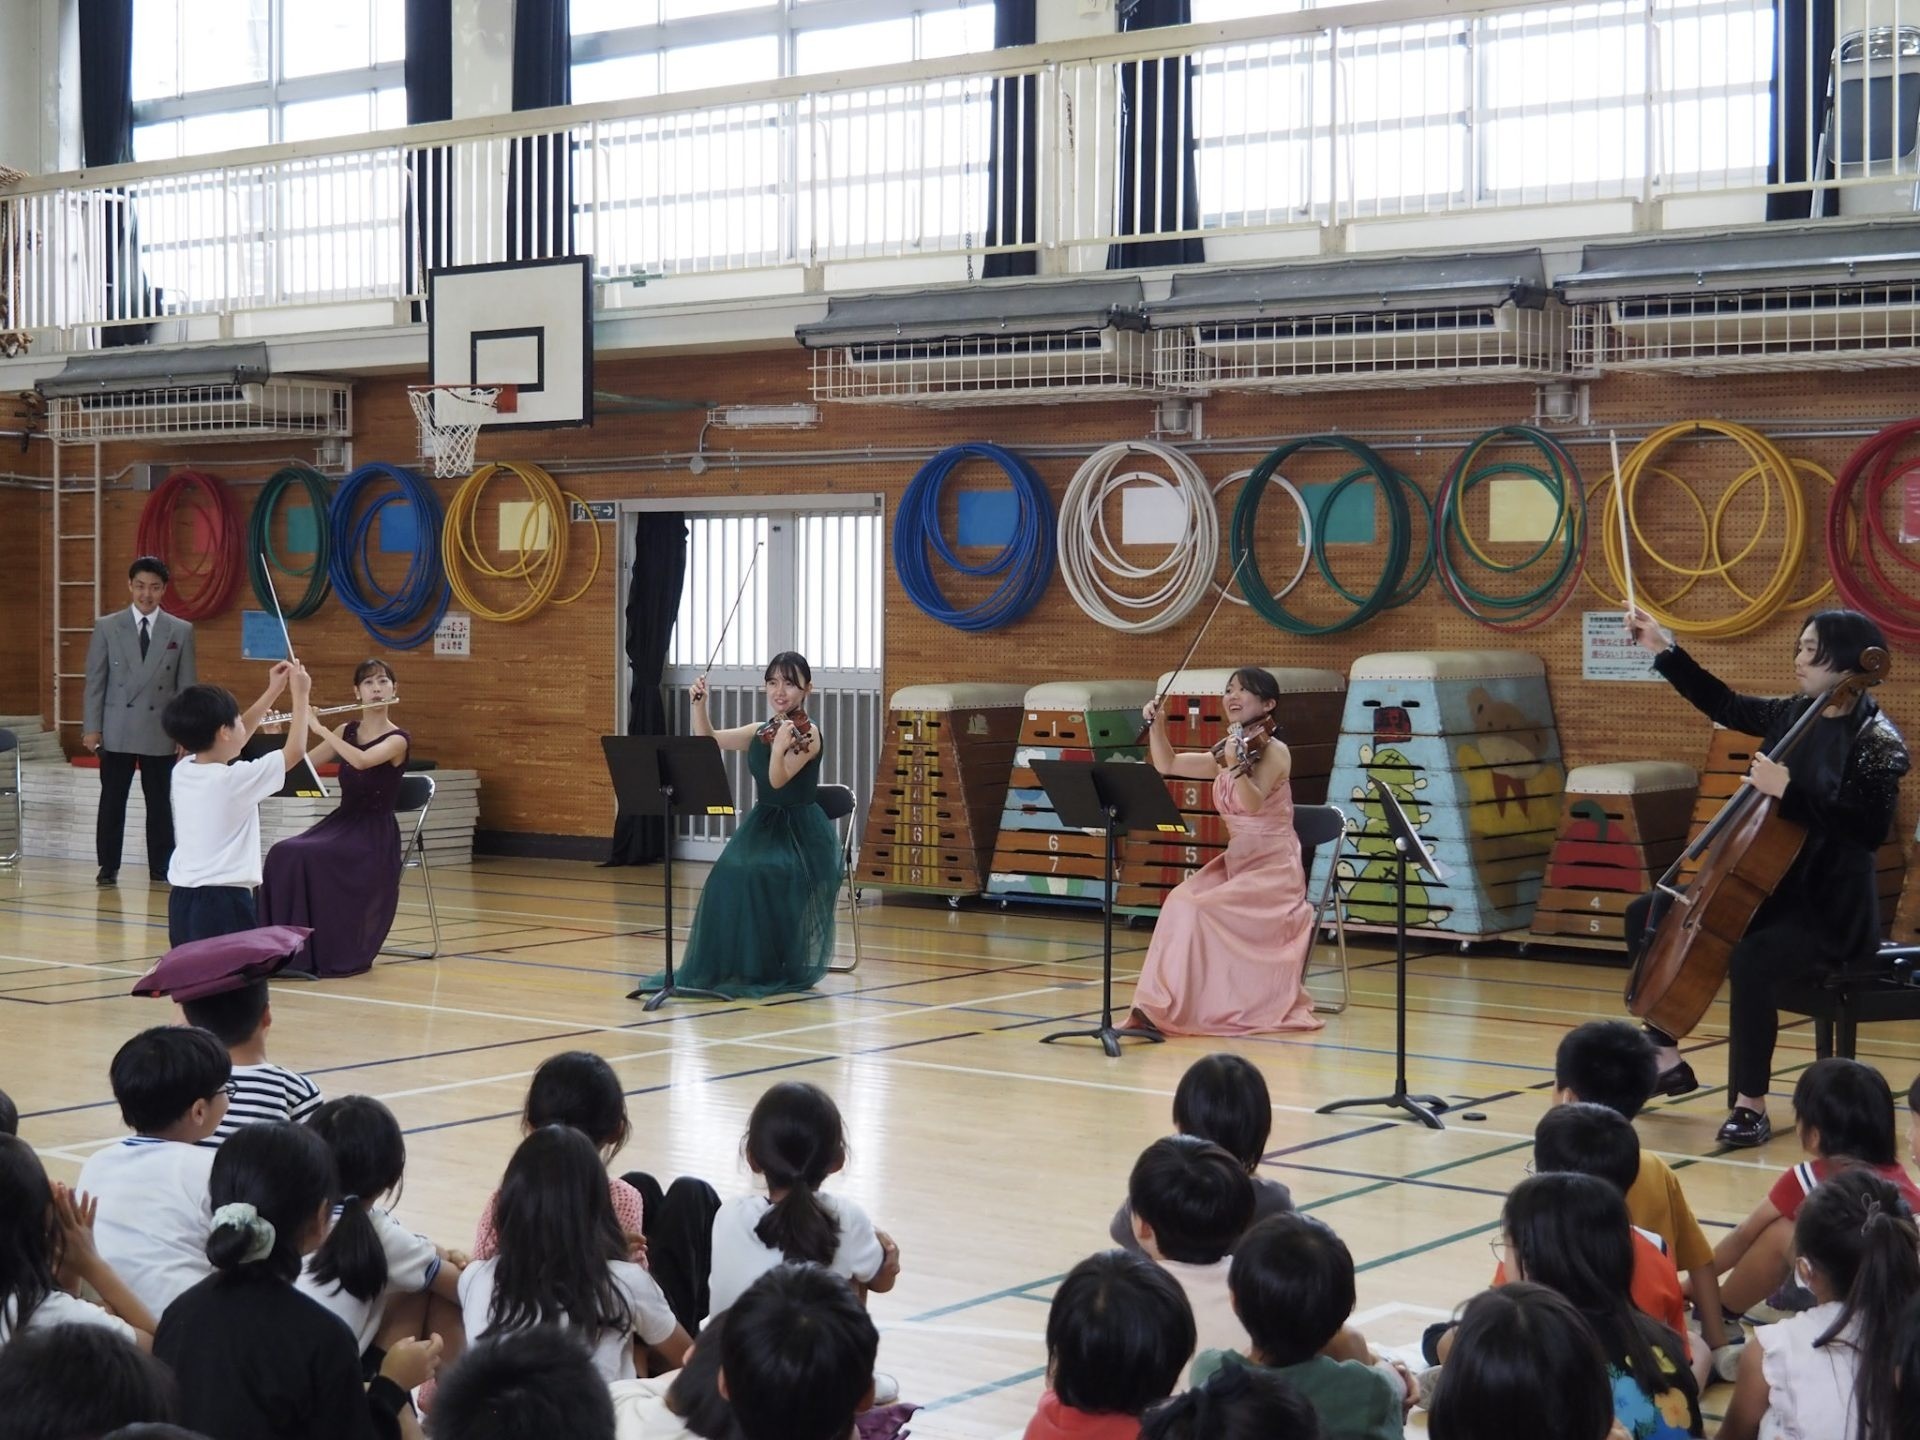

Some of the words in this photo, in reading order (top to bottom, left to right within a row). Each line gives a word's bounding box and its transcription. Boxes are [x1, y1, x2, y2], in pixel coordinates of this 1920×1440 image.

[1052, 720, 1057, 737] 1
[914, 766, 923, 781] 3
[1185, 788, 1197, 805] 3
[913, 806, 922, 821] 5
[913, 827, 922, 842] 6
[1048, 834, 1059, 851] 6
[911, 847, 921, 864] 7
[1185, 846, 1197, 863] 5
[1049, 856, 1059, 872] 7
[911, 869, 921, 883] 8
[1590, 896, 1601, 909] 4
[1589, 919, 1600, 932] 5
